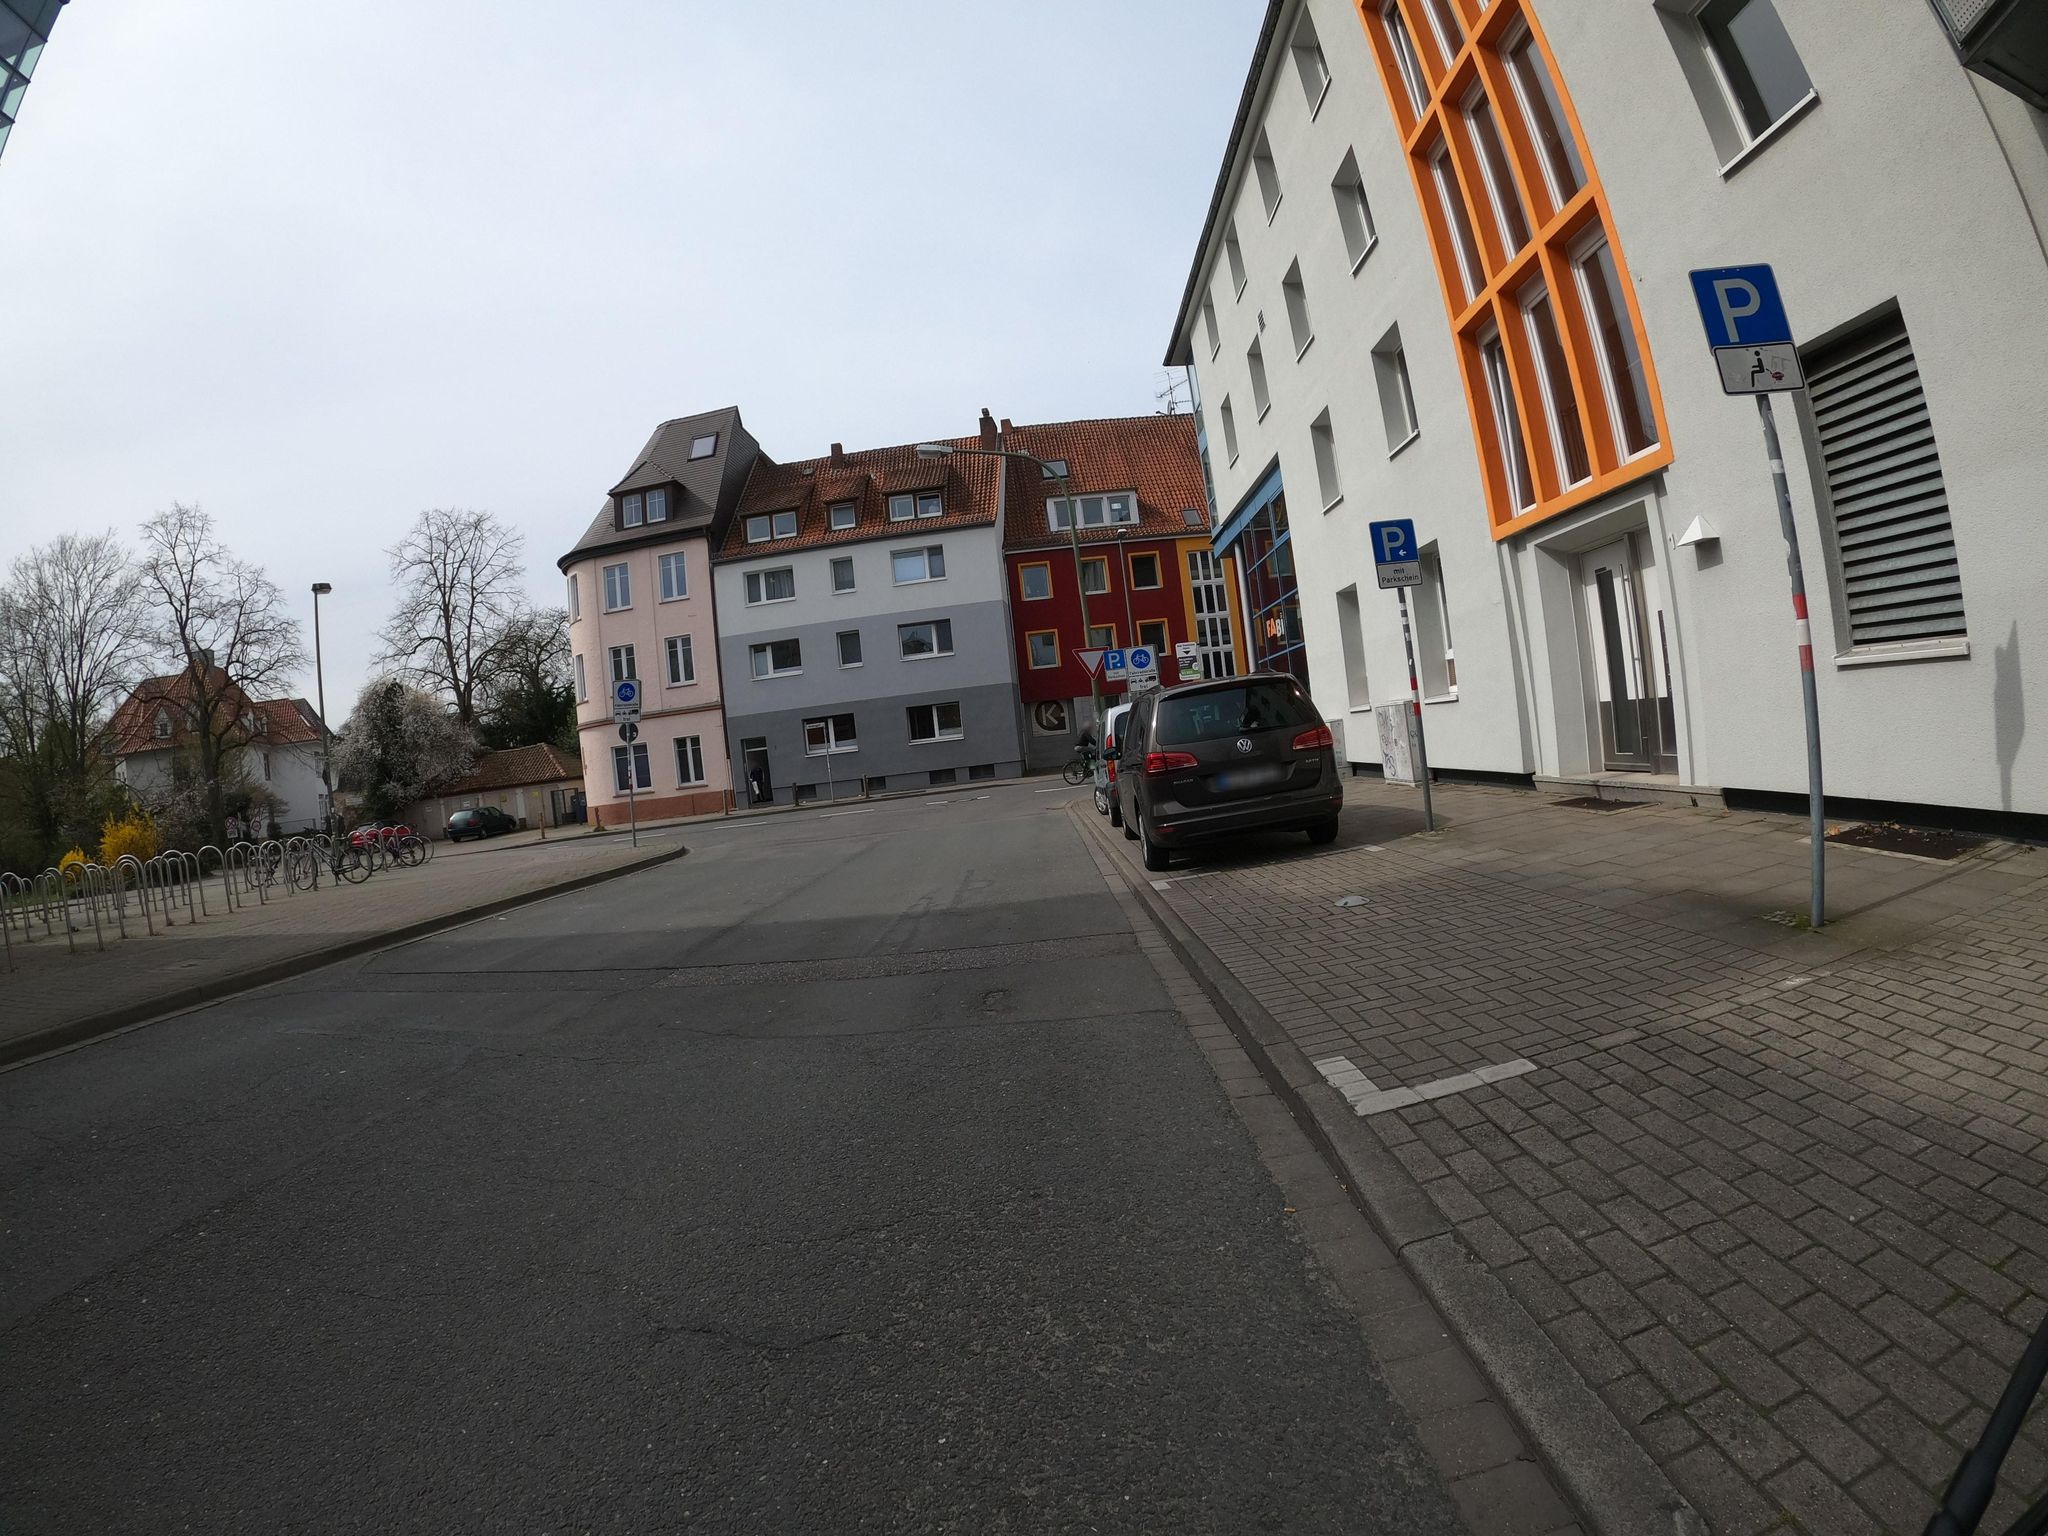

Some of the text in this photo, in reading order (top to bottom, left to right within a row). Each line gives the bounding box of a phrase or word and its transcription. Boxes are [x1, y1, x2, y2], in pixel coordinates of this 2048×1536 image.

[1712, 278, 1761, 343] P
[1381, 526, 1405, 561] P
[1382, 575, 1419, 583] Parkschein
[1108, 652, 1120, 669] P
